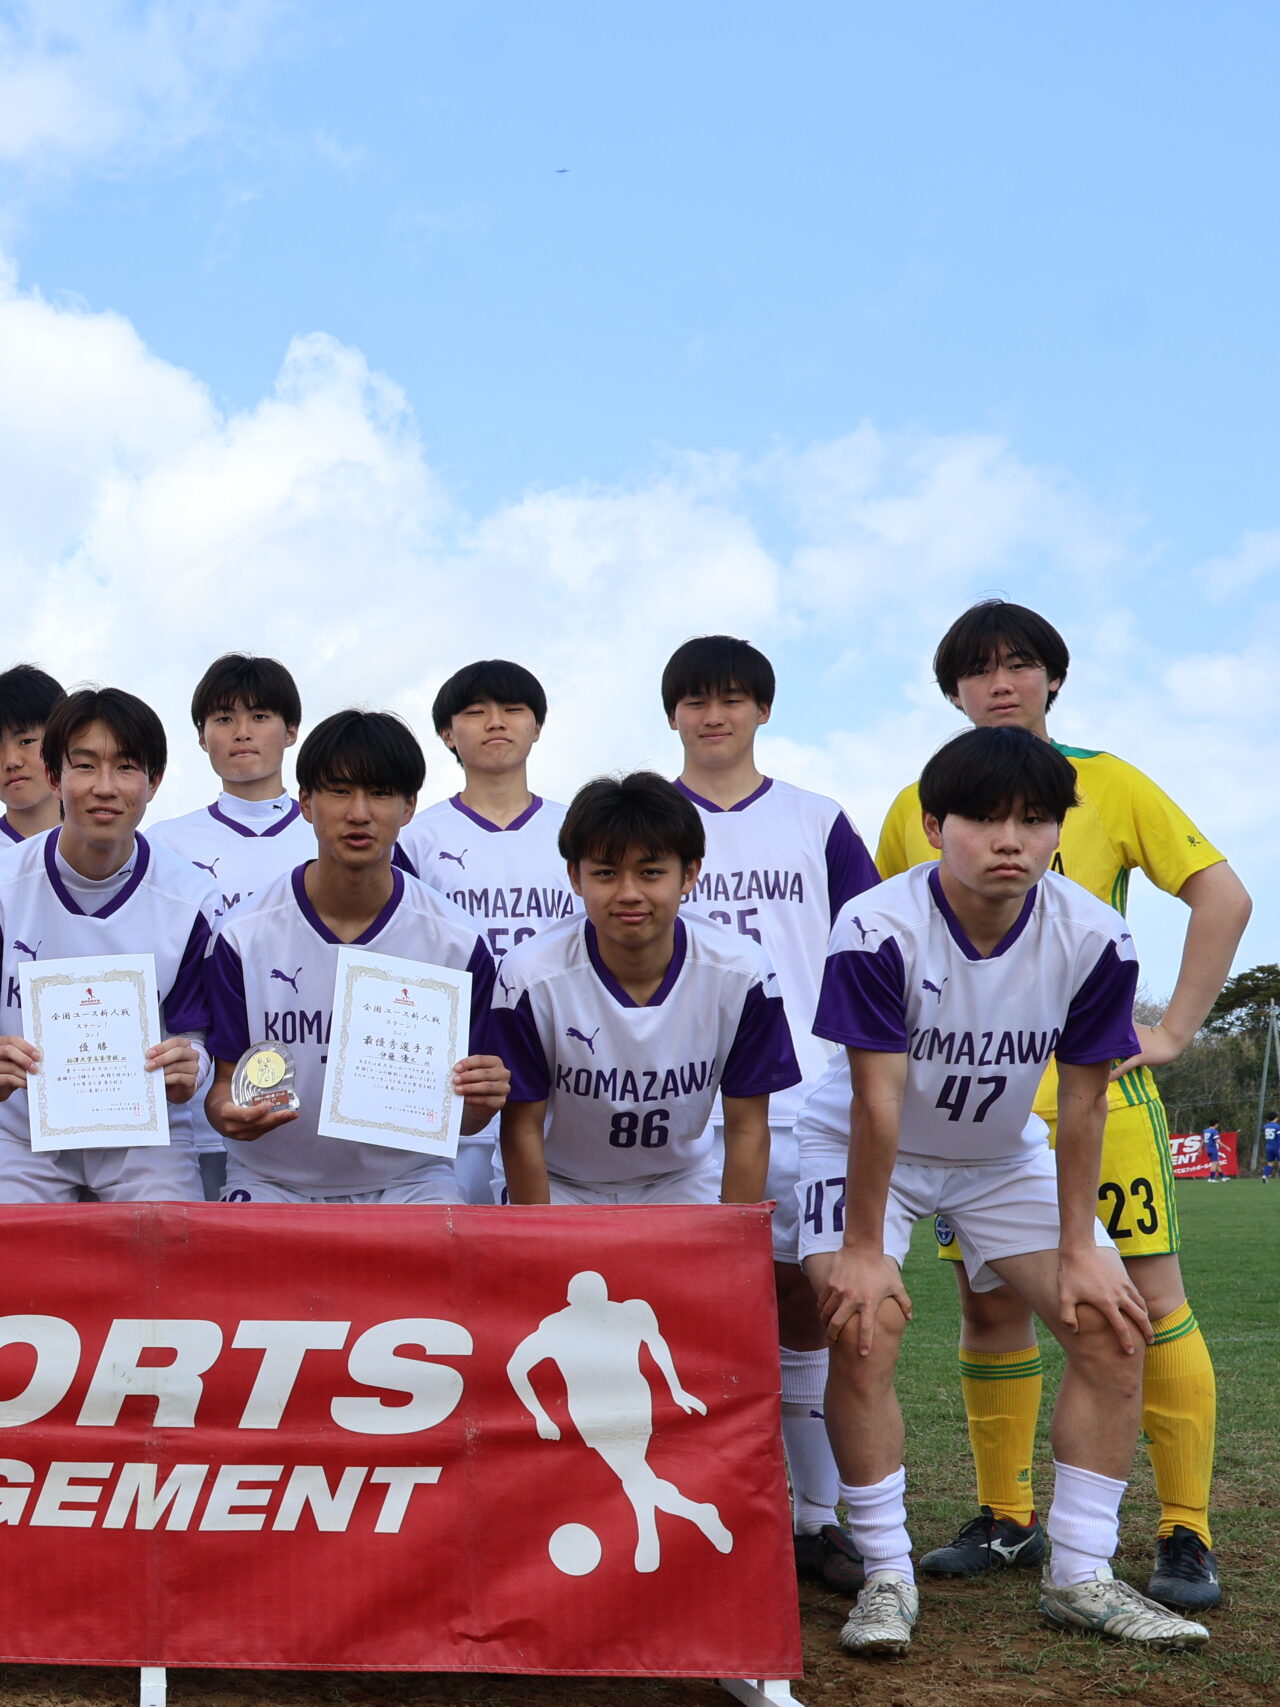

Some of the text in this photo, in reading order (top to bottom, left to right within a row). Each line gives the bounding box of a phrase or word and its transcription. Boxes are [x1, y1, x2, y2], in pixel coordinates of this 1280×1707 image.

[446, 887, 574, 919] OMAZAWA
[51, 1007, 131, 1021] 全国ユース新人戦
[362, 1003, 441, 1025] 全国ユース新人戦
[363, 1035, 435, 1056] 最優秀選手賞
[936, 1075, 1007, 1123] 47
[609, 1108, 670, 1148] 86
[805, 1177, 847, 1235] 47
[1098, 1177, 1158, 1240] 23
